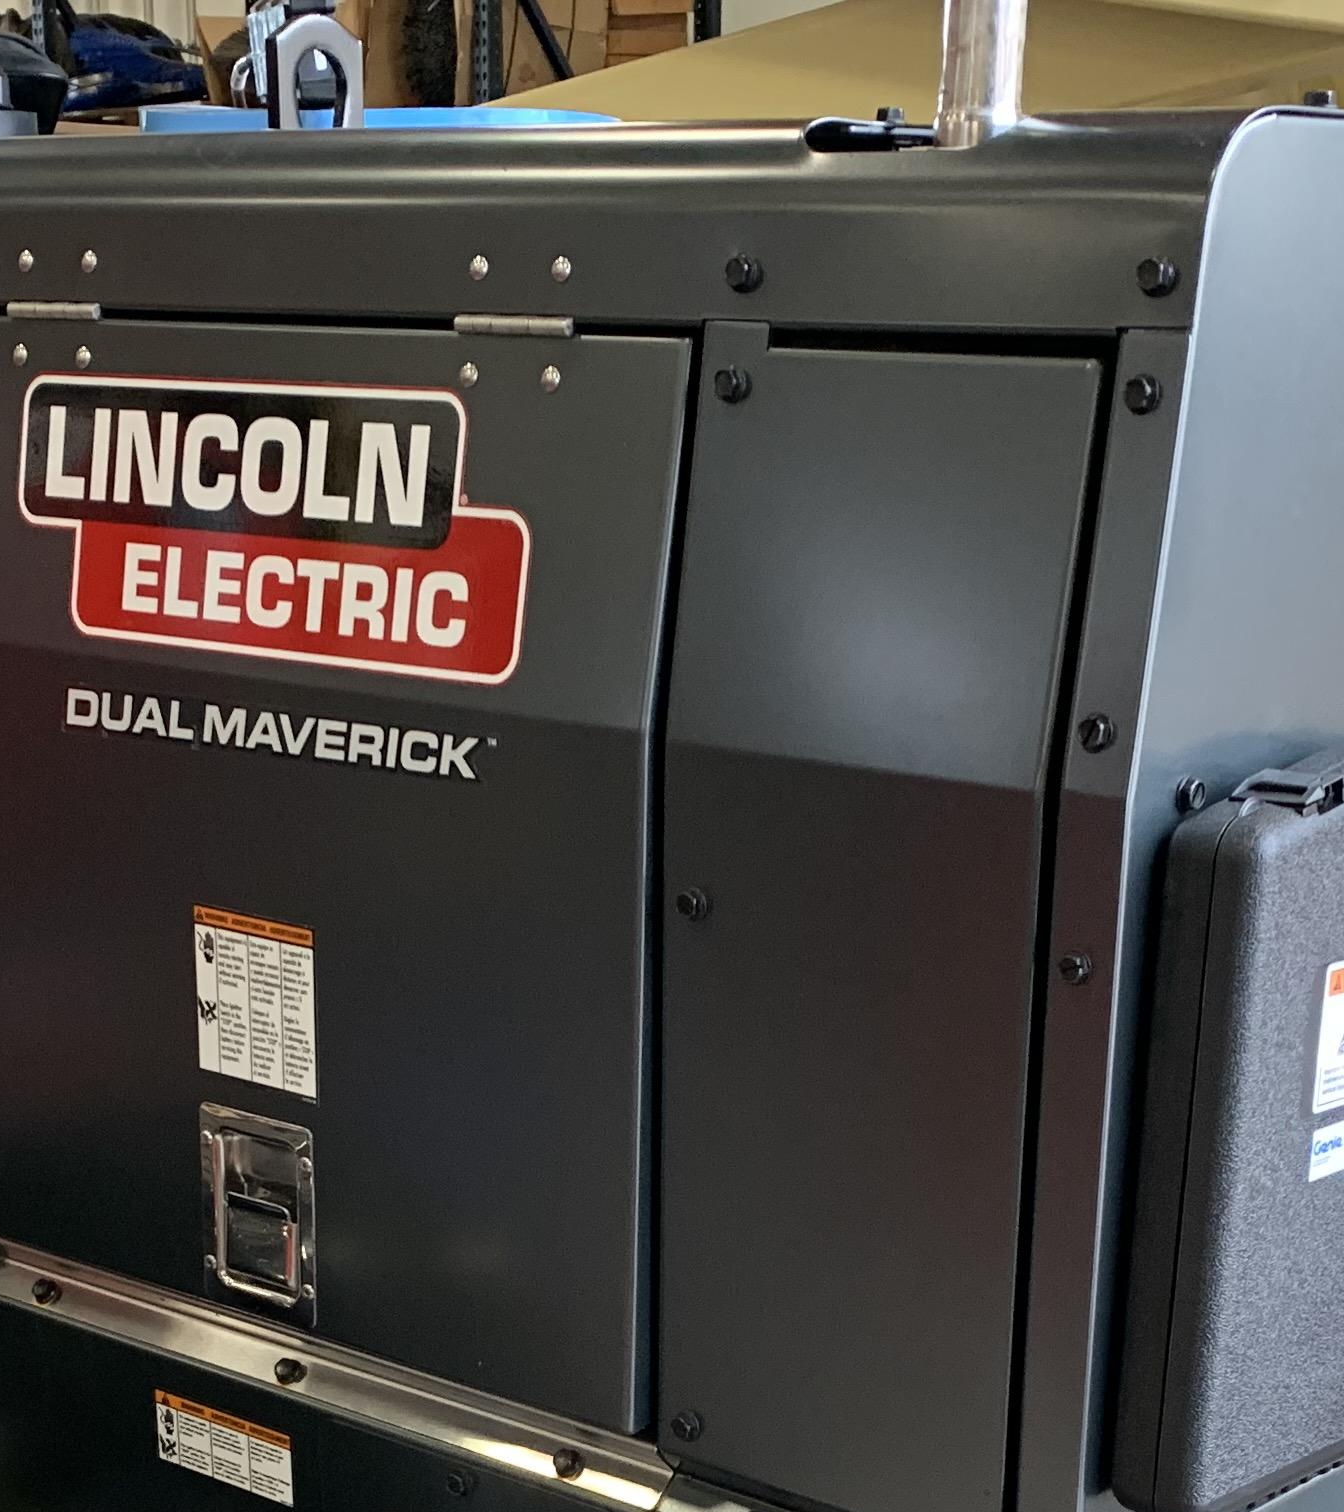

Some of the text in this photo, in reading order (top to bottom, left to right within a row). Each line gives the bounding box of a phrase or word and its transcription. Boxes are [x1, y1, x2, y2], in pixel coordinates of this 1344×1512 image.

[45, 405, 431, 527] LINCOLN
[121, 541, 469, 648] ELECTRIC
[65, 687, 481, 780] DUAL MAVERICK
[1314, 1136, 1343, 1156] Genie
